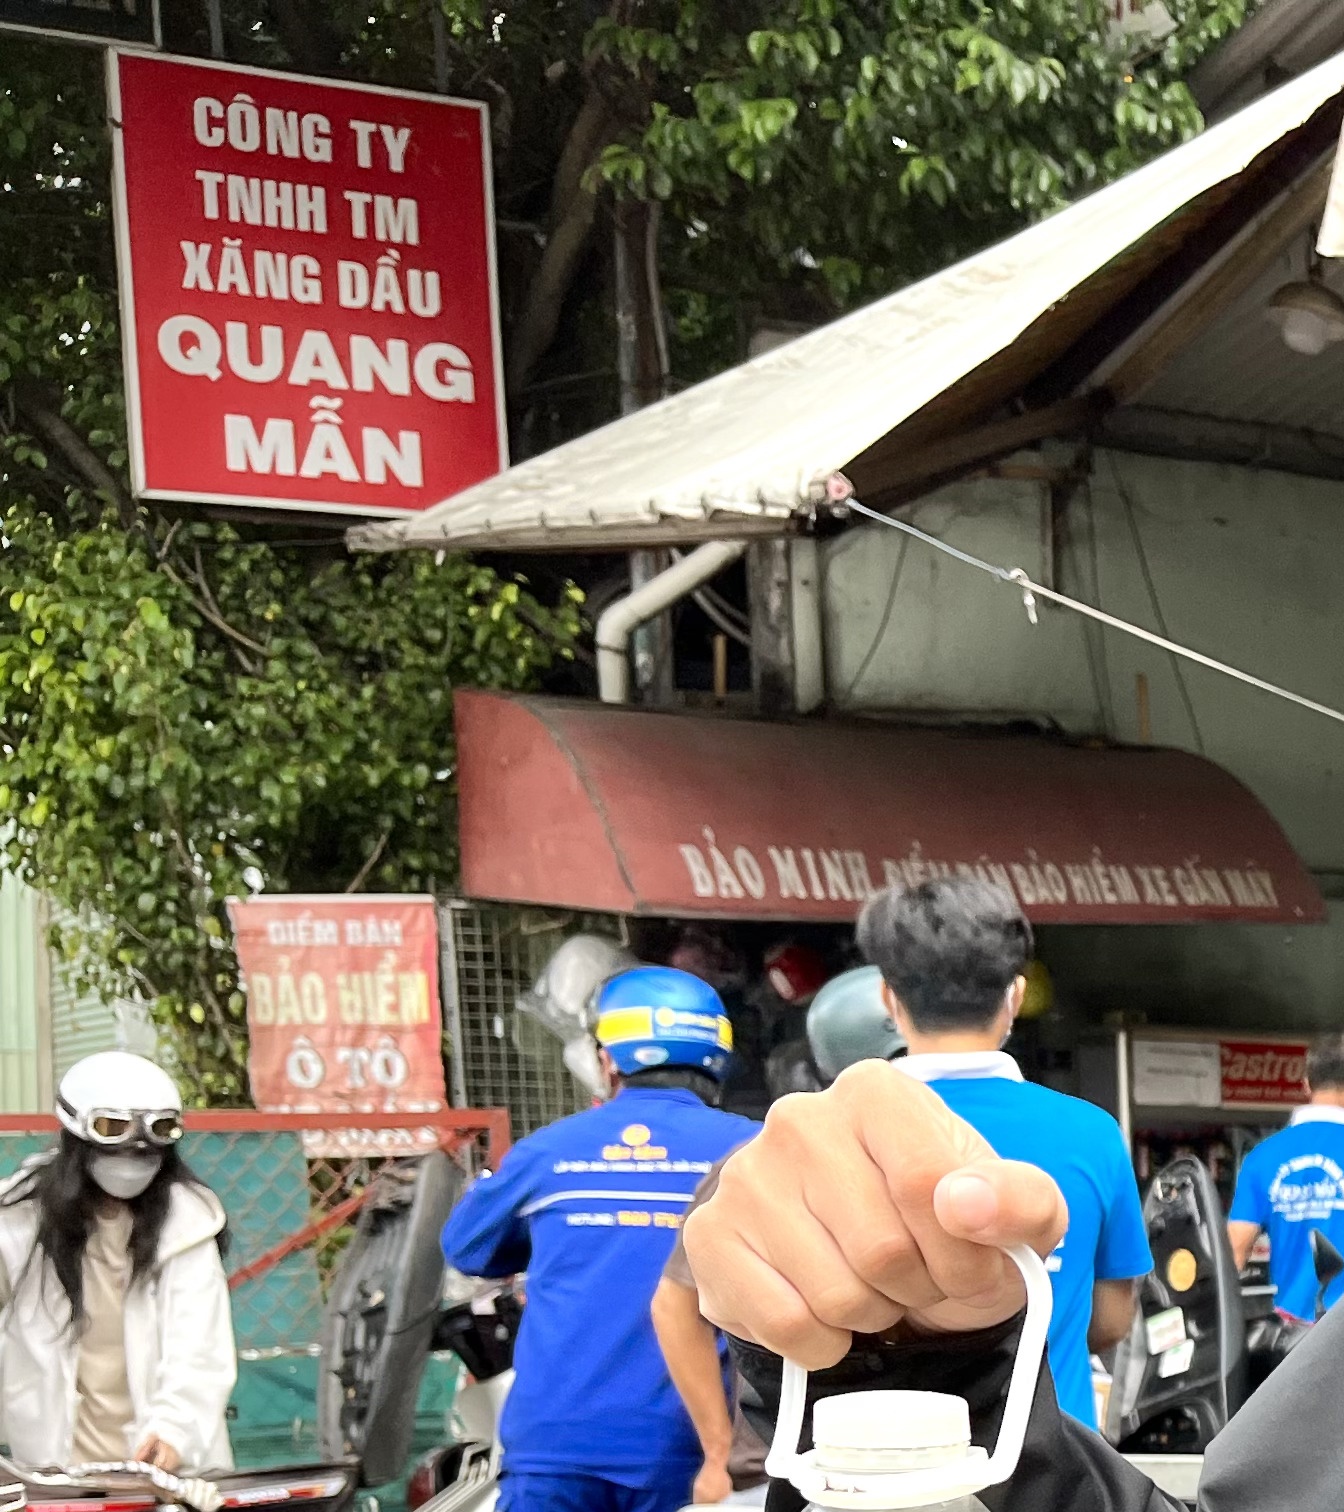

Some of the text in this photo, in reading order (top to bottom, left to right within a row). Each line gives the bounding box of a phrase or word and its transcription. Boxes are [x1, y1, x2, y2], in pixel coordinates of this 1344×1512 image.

[192, 93, 413, 172] CÔNG TY
[195, 170, 419, 246] TNHH TM
[180, 237, 441, 318] XĂNG DẦU
[157, 314, 475, 404] QUANG
[224, 394, 425, 488] MẪN
[679, 825, 766, 900] BẢO
[767, 844, 876, 901] MINH
[1009, 847, 1068, 905] BẢO
[251, 949, 431, 1025] BẢO HIỂM
[285, 1034, 409, 1088] Ô TÔ
[1220, 1047, 1307, 1084] astro
